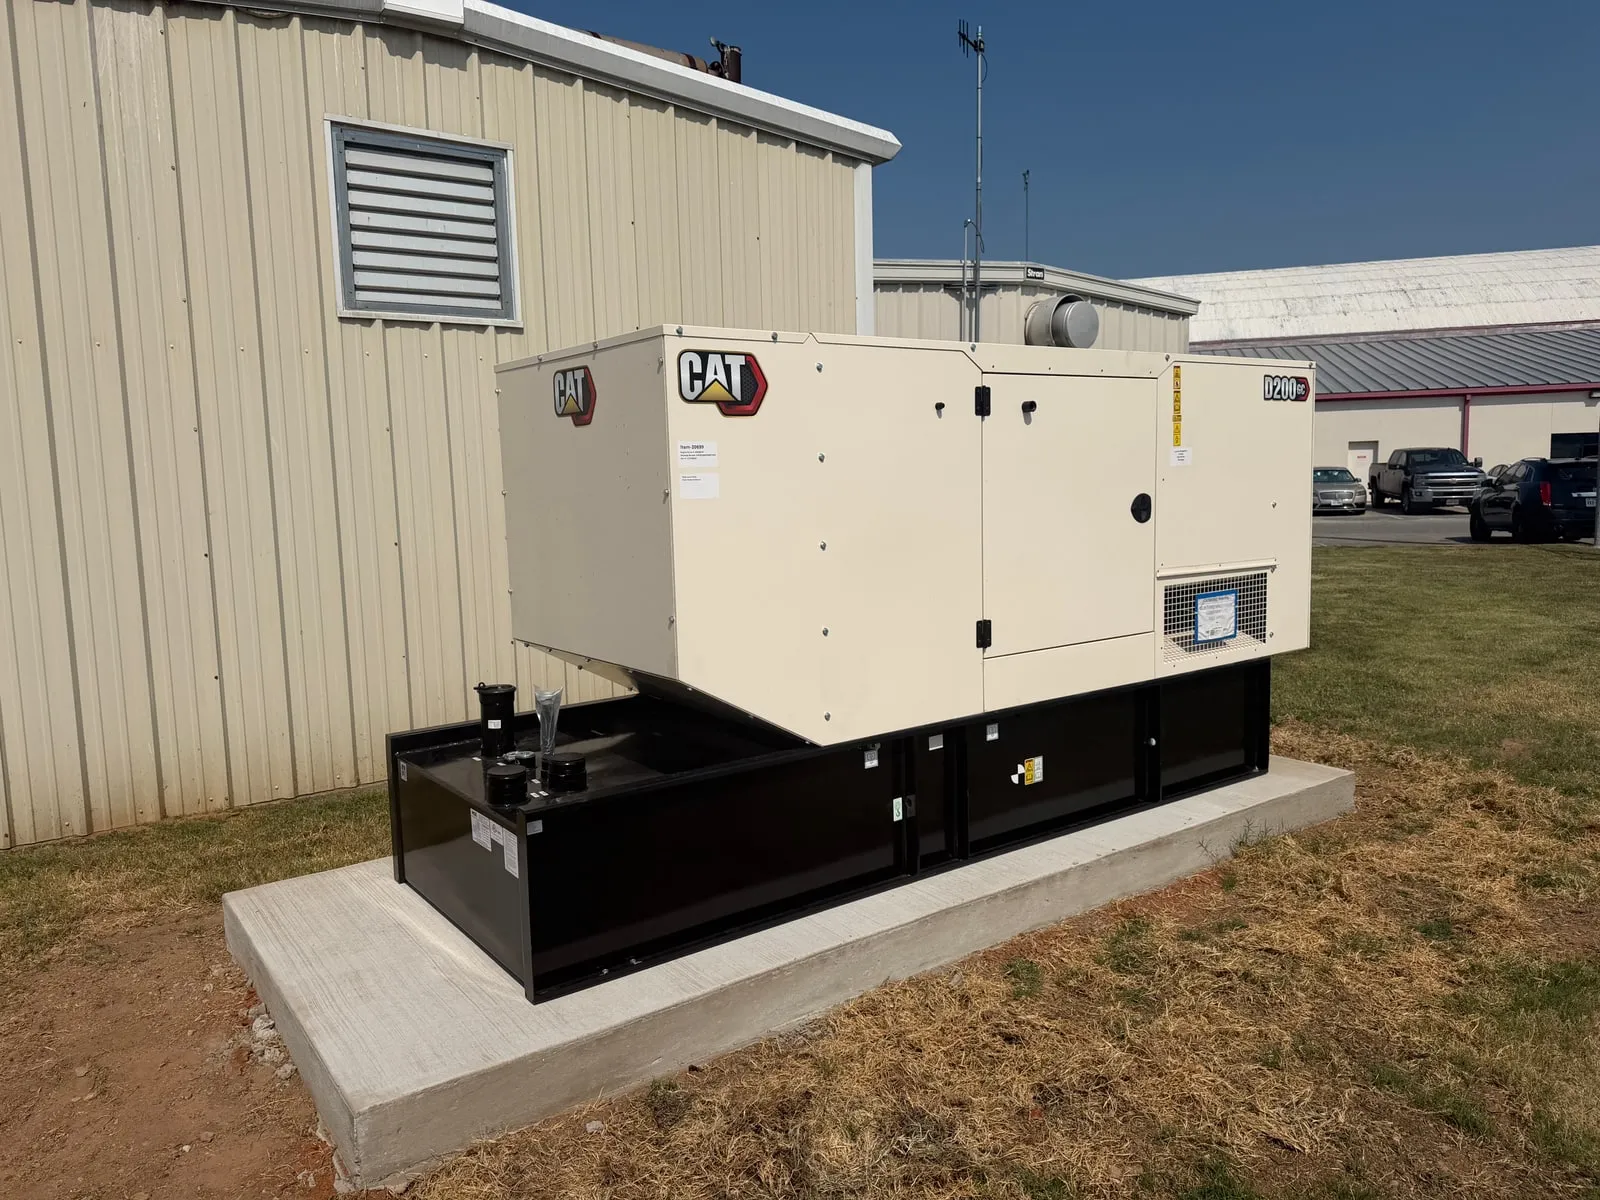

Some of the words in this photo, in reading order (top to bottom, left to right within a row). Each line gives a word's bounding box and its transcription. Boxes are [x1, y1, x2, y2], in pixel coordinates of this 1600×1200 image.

[554, 368, 585, 415] CAT
[680, 351, 746, 401] CAT
[1265, 376, 1297, 399] D200
